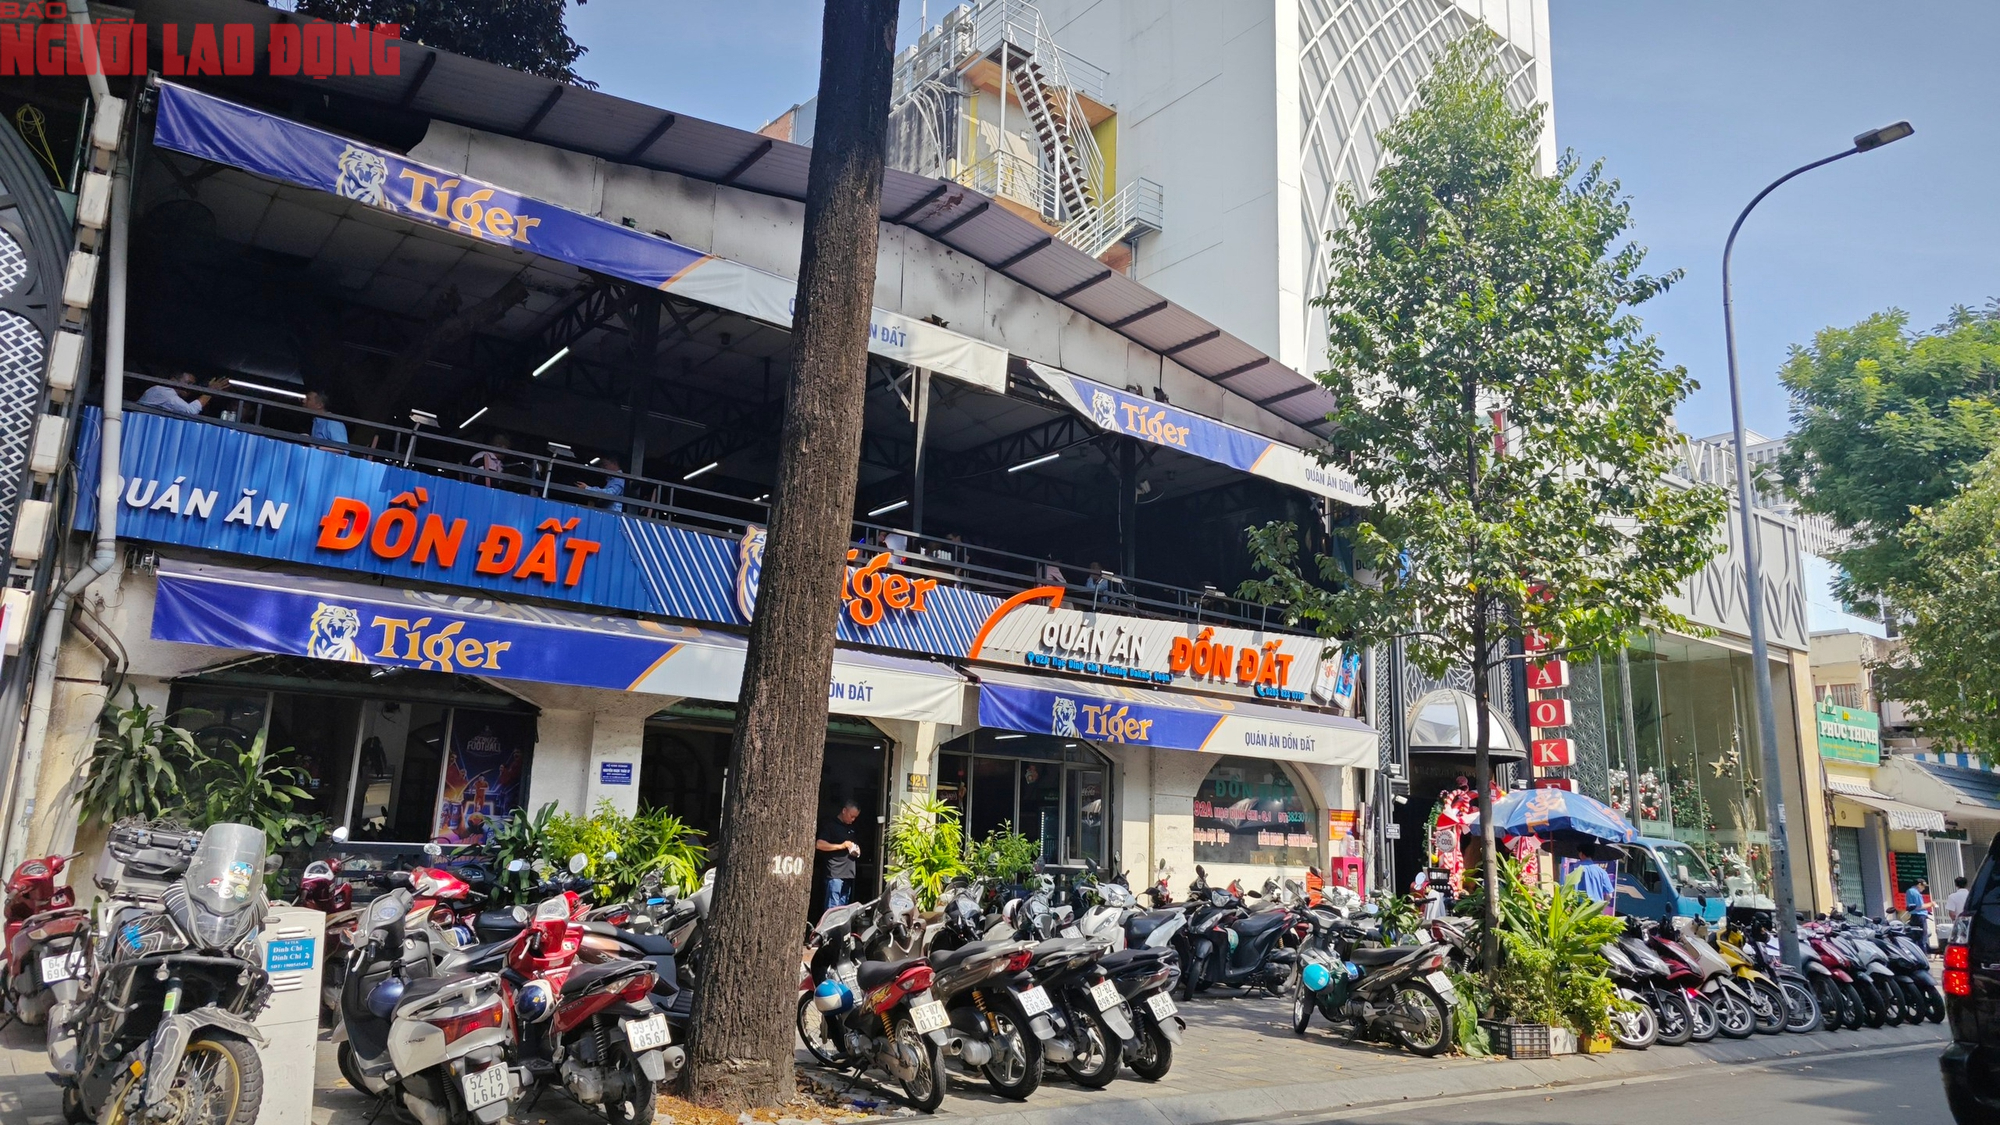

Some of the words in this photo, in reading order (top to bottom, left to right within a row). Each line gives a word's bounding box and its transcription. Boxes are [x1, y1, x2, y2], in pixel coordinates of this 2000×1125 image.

[881, 325, 906, 348] ĐẤT
[1305, 468, 1325, 486] QUÁN
[224, 488, 289, 530] ĂN
[316, 486, 468, 568] ĐỒN
[475, 517, 600, 586] ĐẤT
[841, 549, 937, 626] iger
[1043, 619, 1107, 656] QUÁN
[1112, 626, 1146, 660] ĂN
[1169, 627, 1233, 678] ĐỒN
[1237, 639, 1294, 687] ĐẤT
[849, 680, 873, 702] ĐẤT
[1245, 731, 1267, 747] QUÁN
[1269, 733, 1280, 749] ĂN
[1282, 733, 1299, 750] ĐỒN
[1300, 735, 1315, 752] ĐẤT
[1194, 801, 1213, 818] 92A
[772, 854, 805, 875] 160
[632, 1018, 660, 1035] 59-P1
[920, 1015, 944, 1031] 0123
[469, 1068, 502, 1091] 52-F8
[473, 1082, 506, 1105] 4642
